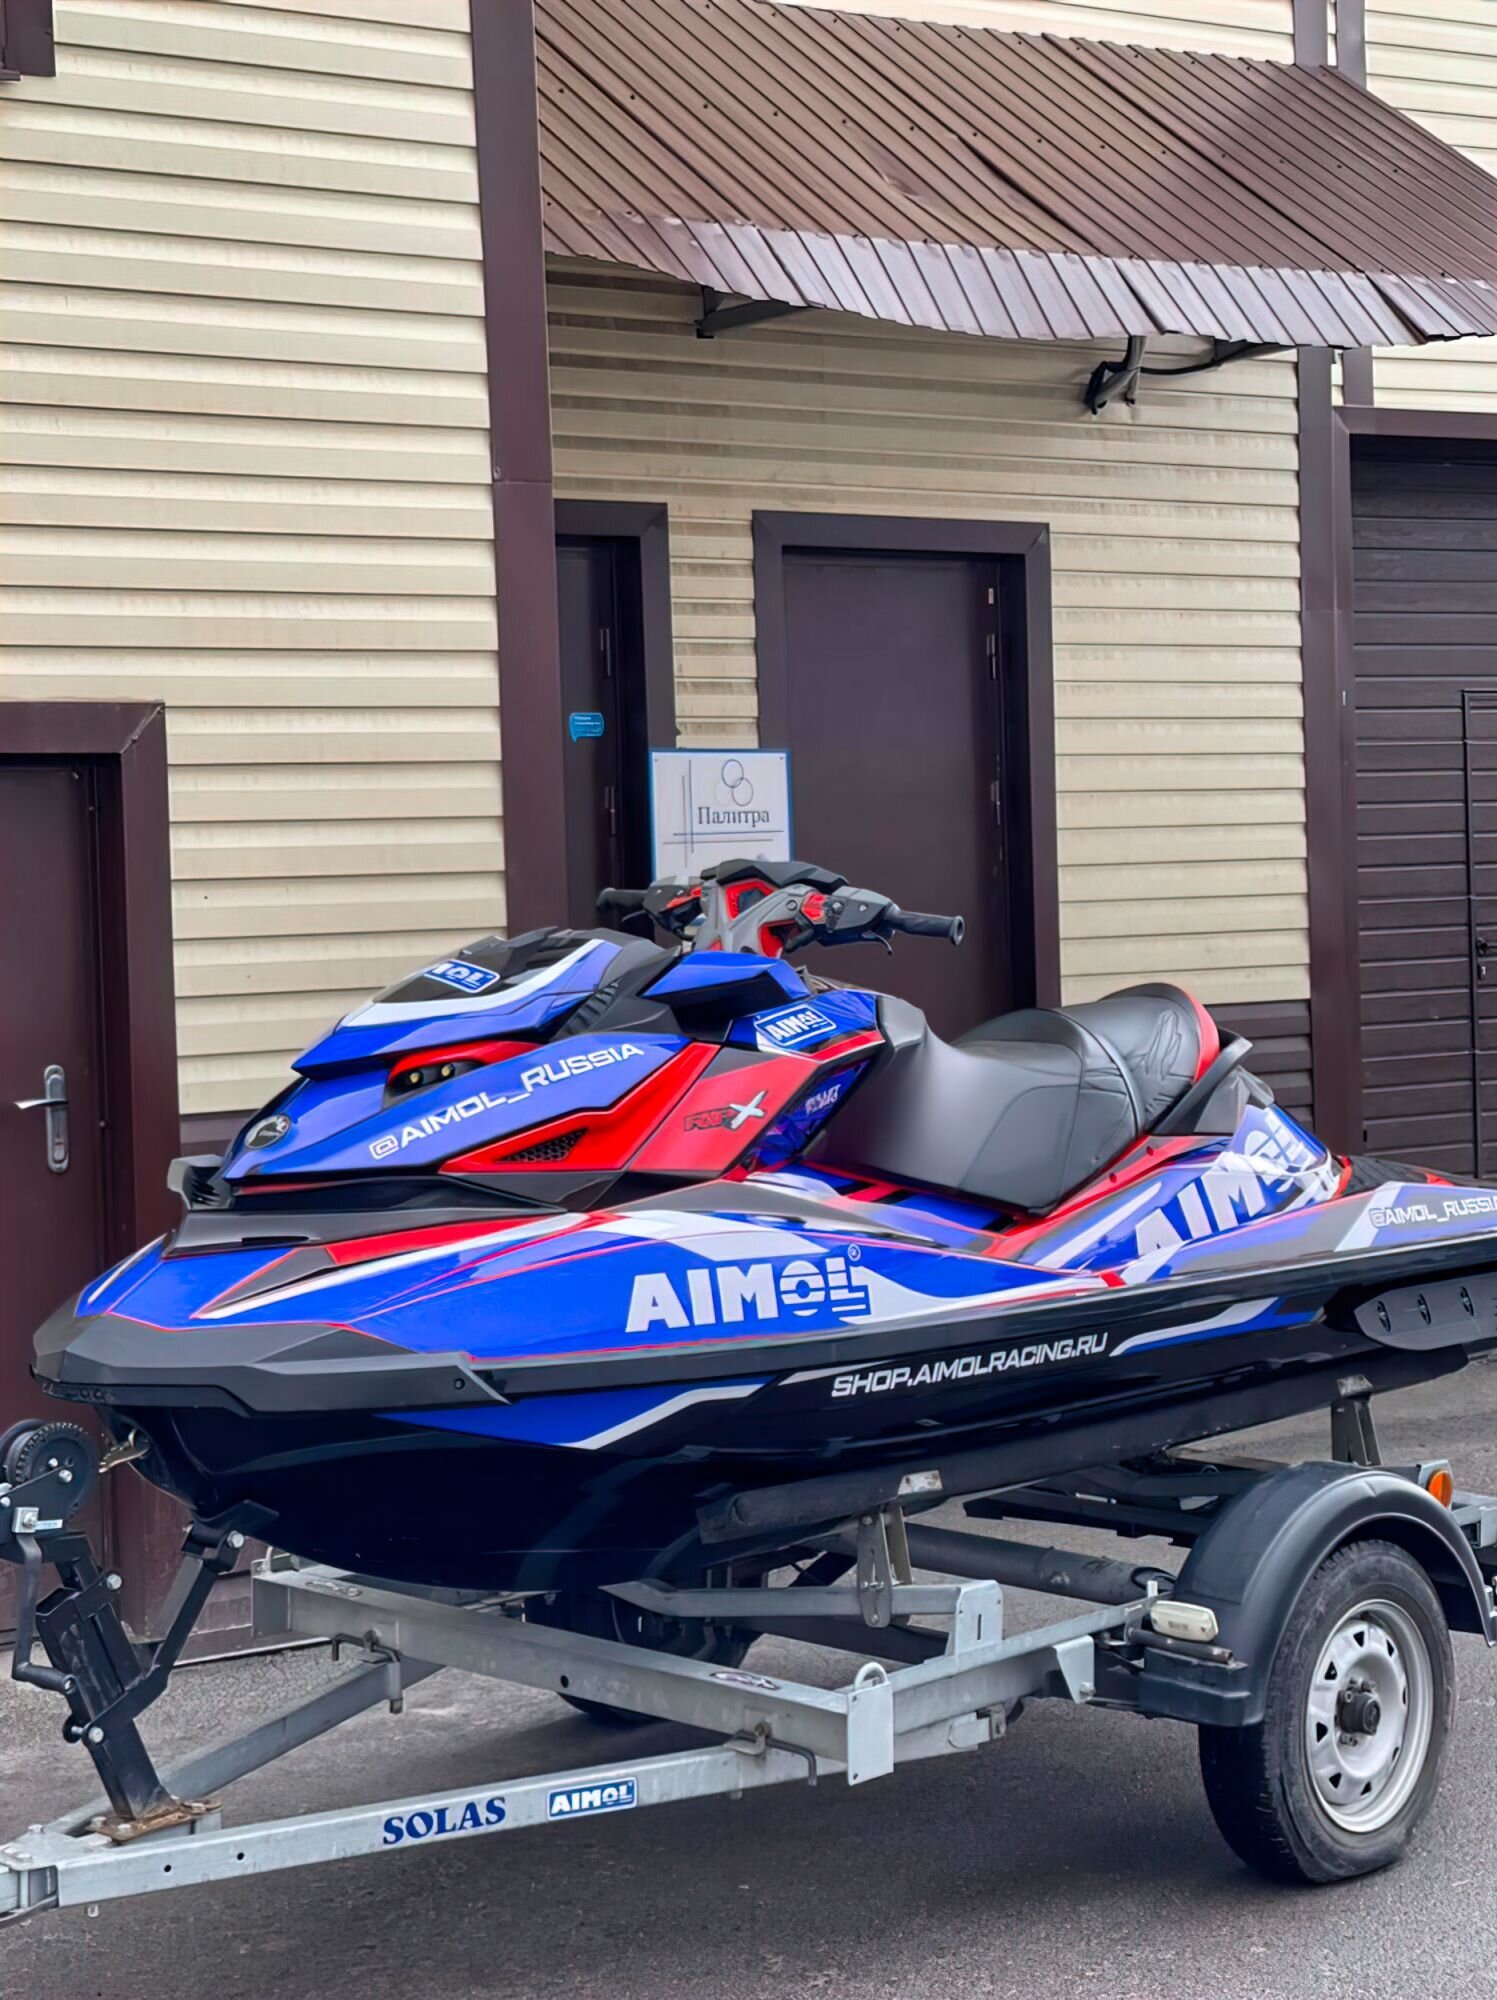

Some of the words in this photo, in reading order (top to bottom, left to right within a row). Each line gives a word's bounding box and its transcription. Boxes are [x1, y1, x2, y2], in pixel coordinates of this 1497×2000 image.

[698, 806, 770, 828] Палитра
[368, 1043, 645, 1160] @AIMOL_RUSSIA
[831, 1332, 1108, 1398] SHOP.AIMOLRACING.RU
[383, 1796, 506, 1845] SOLAS
[551, 1783, 633, 1814] AIMOL
